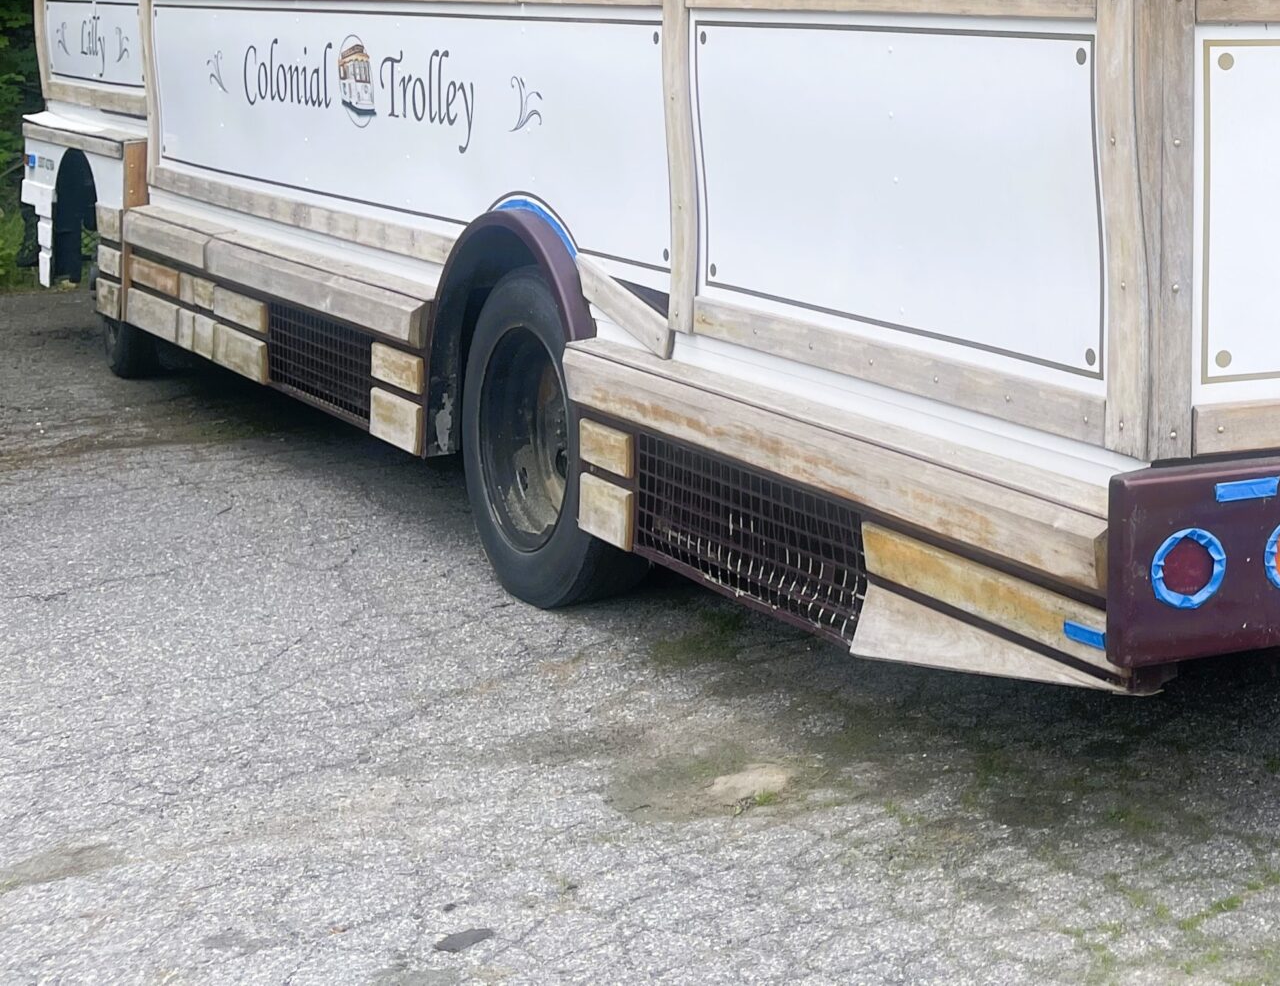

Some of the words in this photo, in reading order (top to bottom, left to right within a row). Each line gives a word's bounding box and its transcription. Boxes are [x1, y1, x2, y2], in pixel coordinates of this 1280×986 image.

[81, 16, 106, 78] Lilly
[243, 38, 332, 108] Colonial
[379, 50, 474, 154] Trolley
